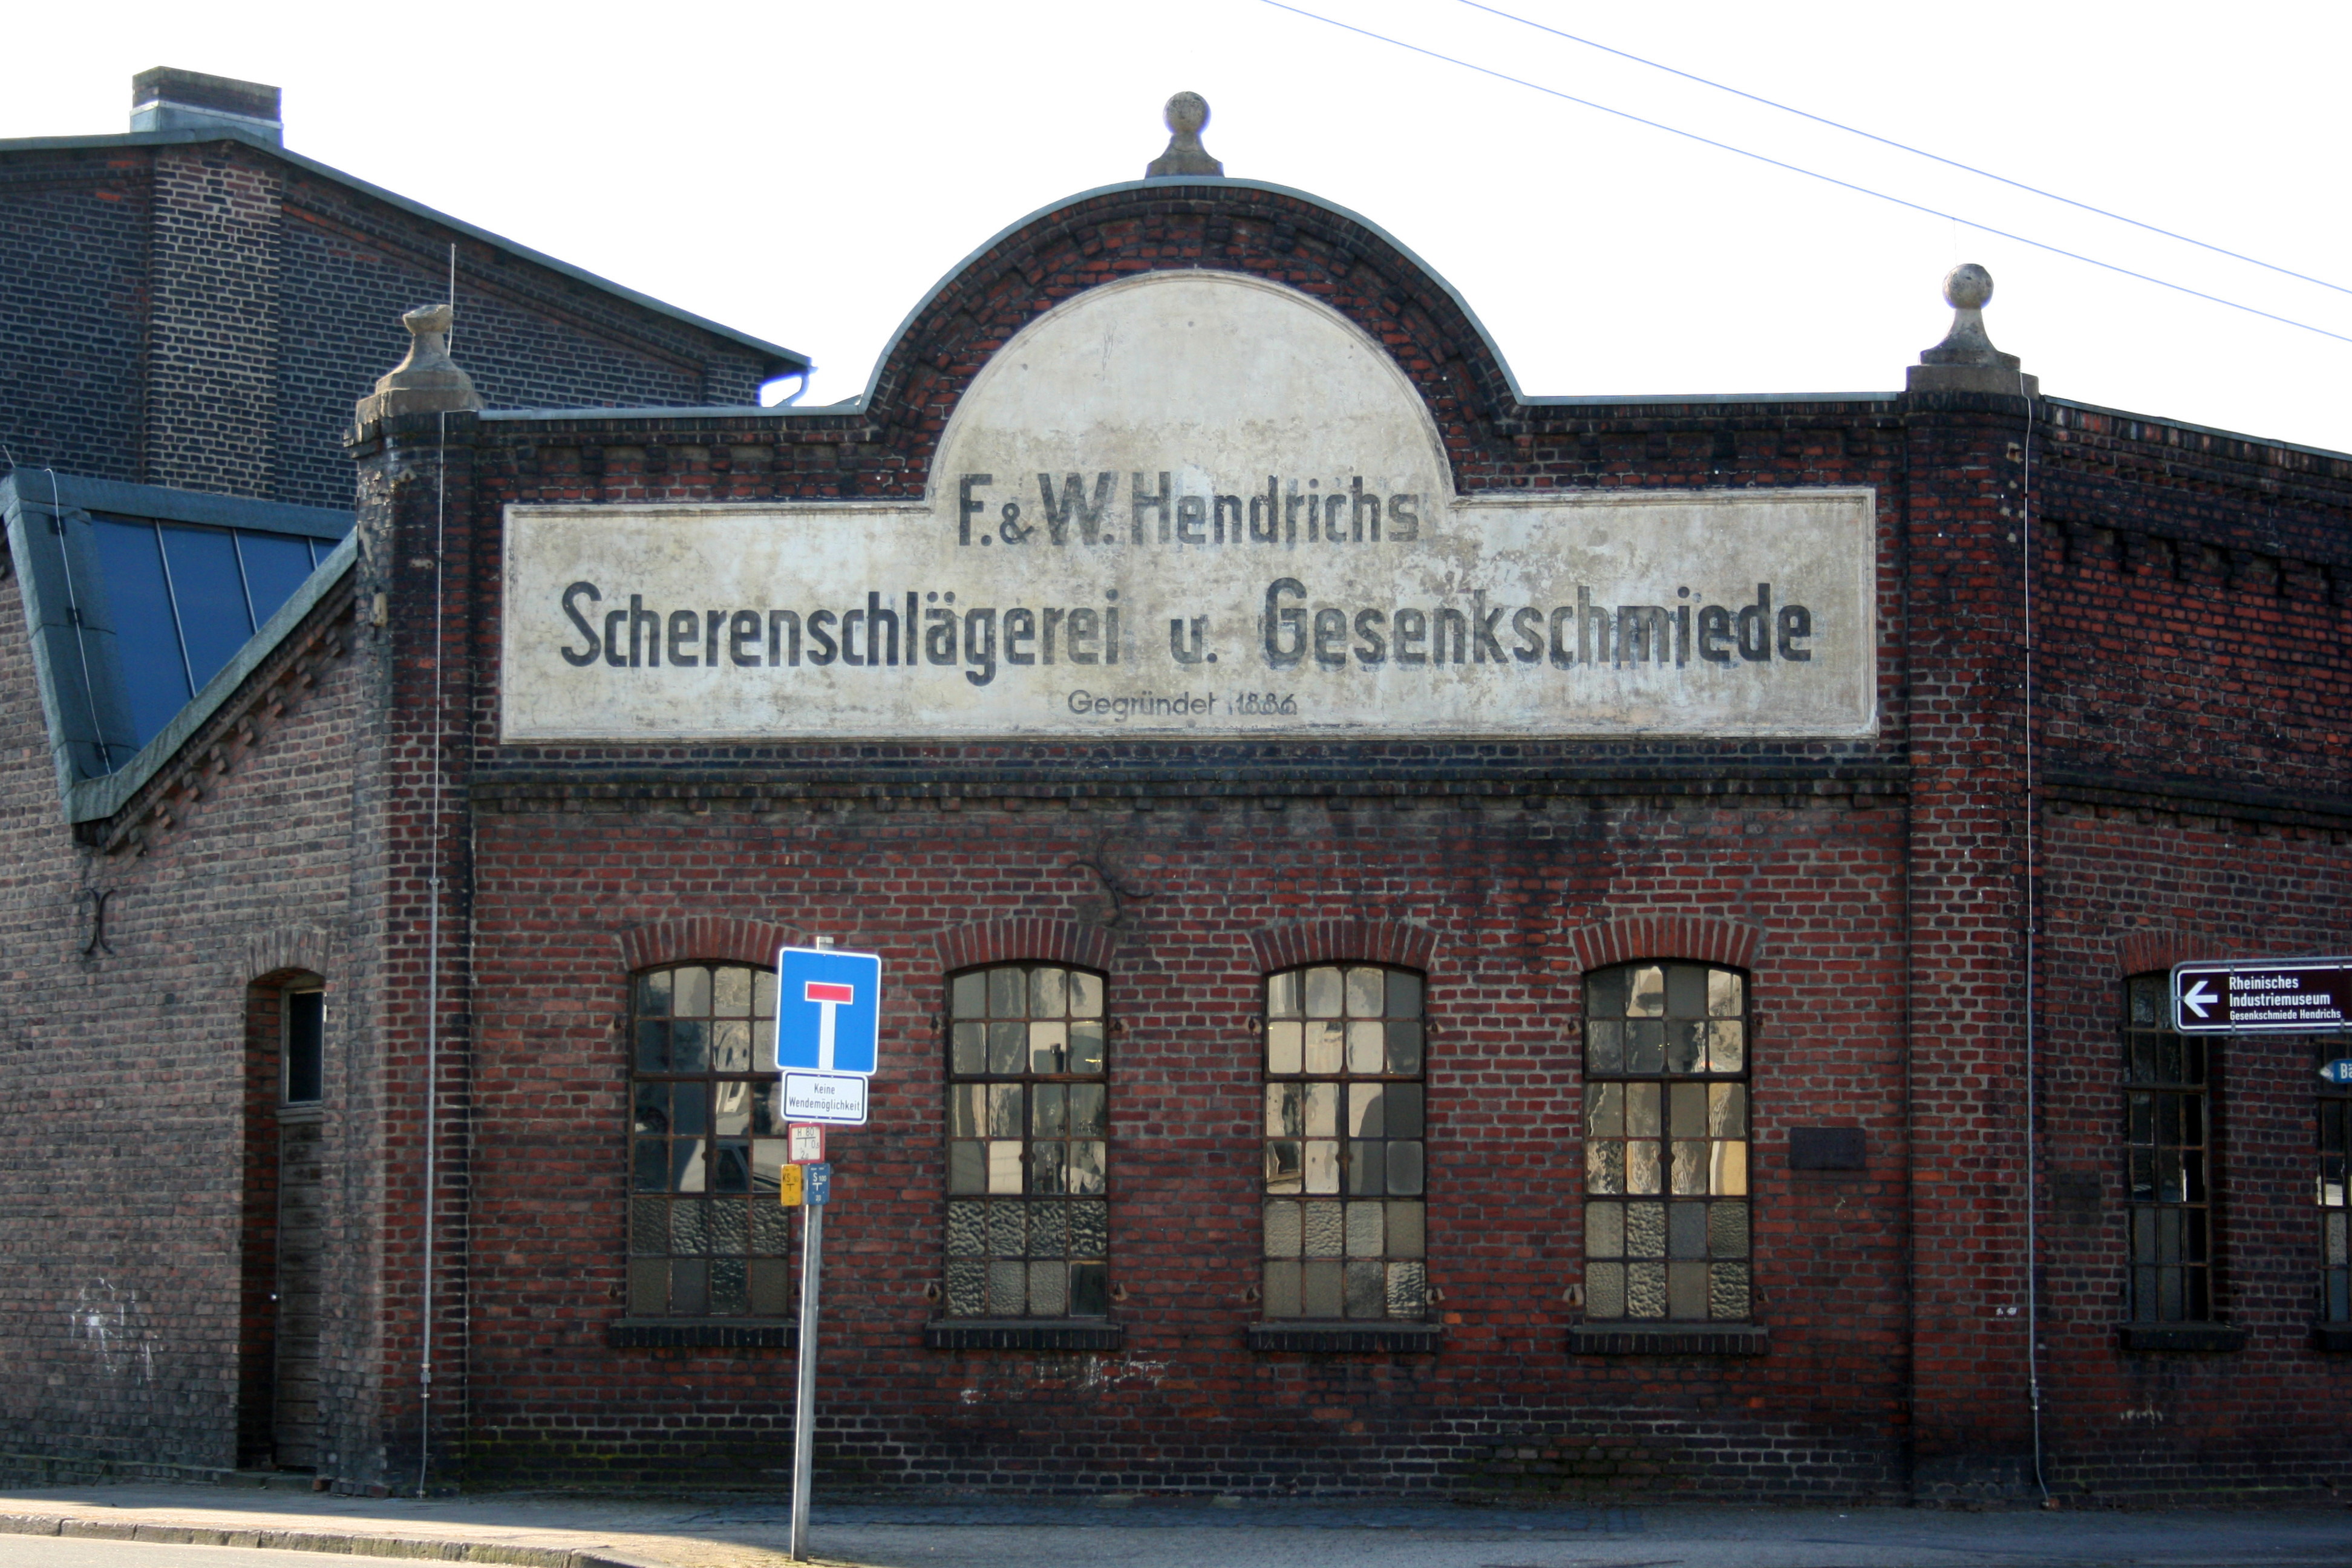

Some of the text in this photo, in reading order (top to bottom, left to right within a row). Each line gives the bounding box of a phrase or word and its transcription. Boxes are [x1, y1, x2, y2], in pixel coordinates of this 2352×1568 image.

[1131, 471, 1420, 546] Hendrichs
[560, 577, 1812, 687] Scherenschlägerei u. Gesenkschmiede
[1068, 689, 1298, 722] Gegründet 1886
[2229, 976, 2299, 990] Rheinisches
[2229, 993, 2331, 1007] Industriemuseum
[2230, 1008, 2341, 1021] Gesenkschmiede Hendrichs
[814, 1083, 835, 1094] Keine
[789, 1096, 860, 1112] Wendemöglichkeit
[797, 1126, 814, 1137] H 80
[813, 1172, 818, 1182] S
